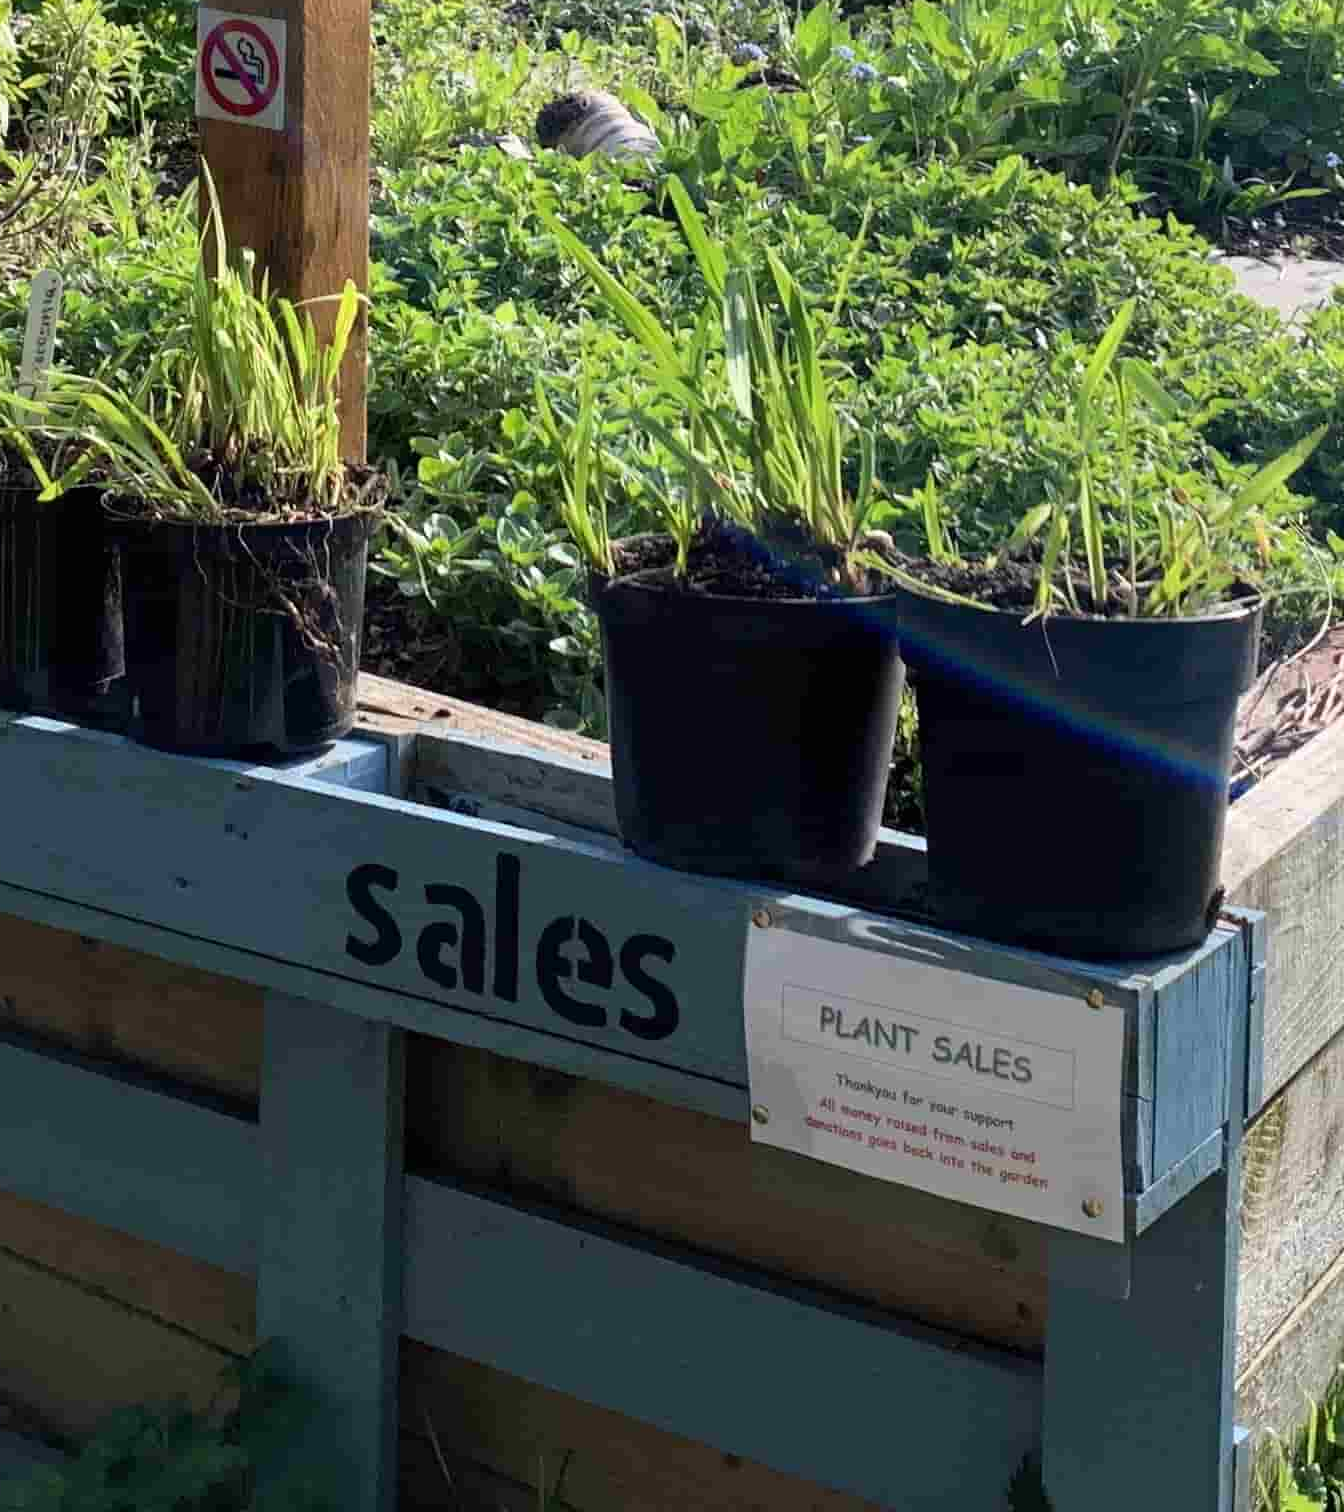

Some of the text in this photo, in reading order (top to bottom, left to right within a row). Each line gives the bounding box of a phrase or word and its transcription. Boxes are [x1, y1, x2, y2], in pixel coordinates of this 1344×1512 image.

[819, 1004, 1033, 1085] PLANT SALES
[819, 1095, 1036, 1165] All money raised from sales and
[834, 1073, 1015, 1132] Thankyou for your support
[867, 1134, 897, 1152] goes
[902, 1141, 934, 1159] back
[939, 1152, 965, 1170] into
[970, 1160, 993, 1178] the
[999, 1168, 1049, 1193] garden
